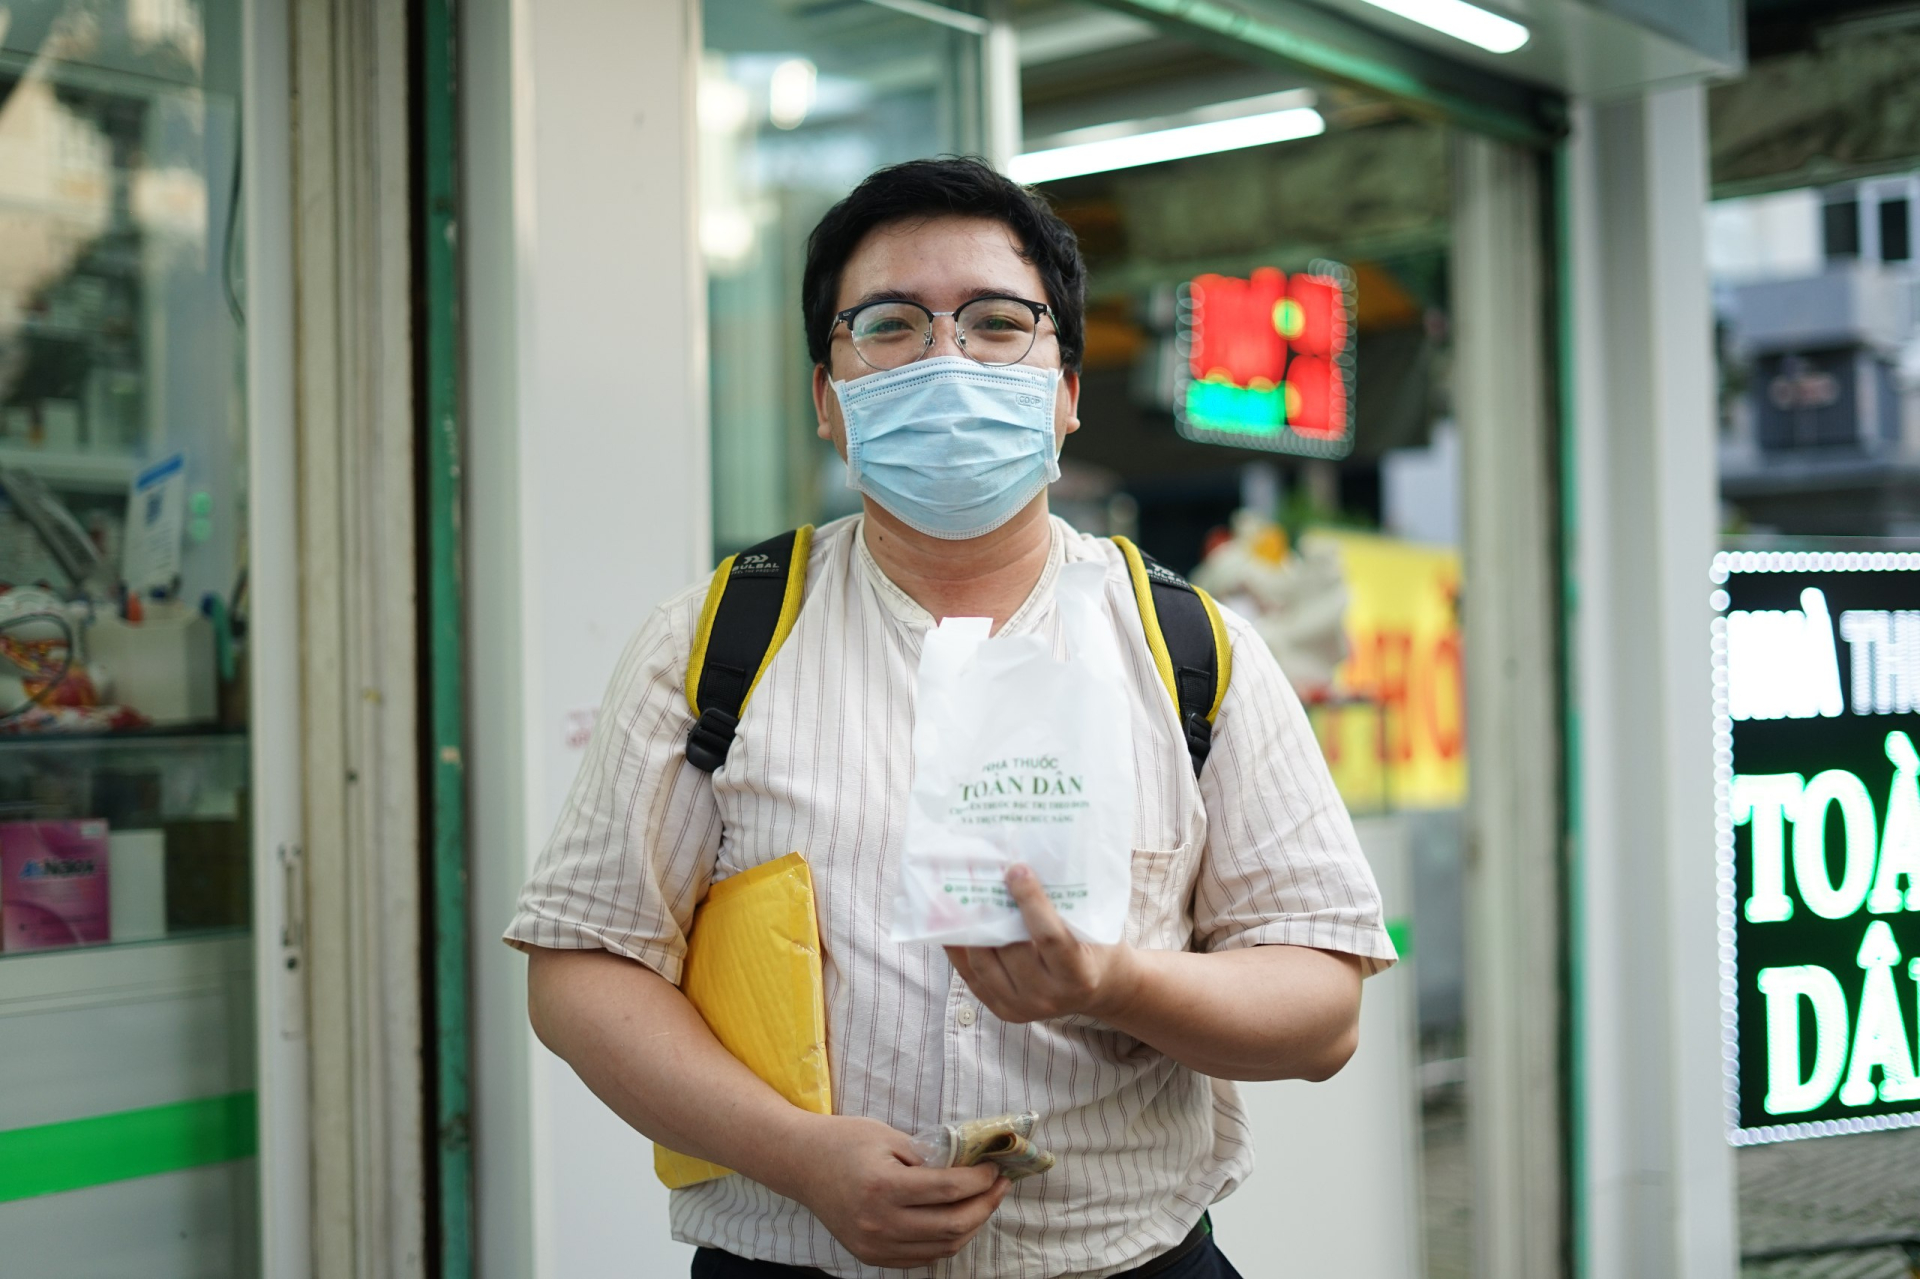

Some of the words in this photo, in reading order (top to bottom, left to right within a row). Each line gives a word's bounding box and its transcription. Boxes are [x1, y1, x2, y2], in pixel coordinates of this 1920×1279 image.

[731, 562, 780, 571] BULBAL
[1012, 754, 1059, 770] THUỐC
[957, 771, 1024, 802] TOÀN
[1032, 770, 1084, 796] DÂN
